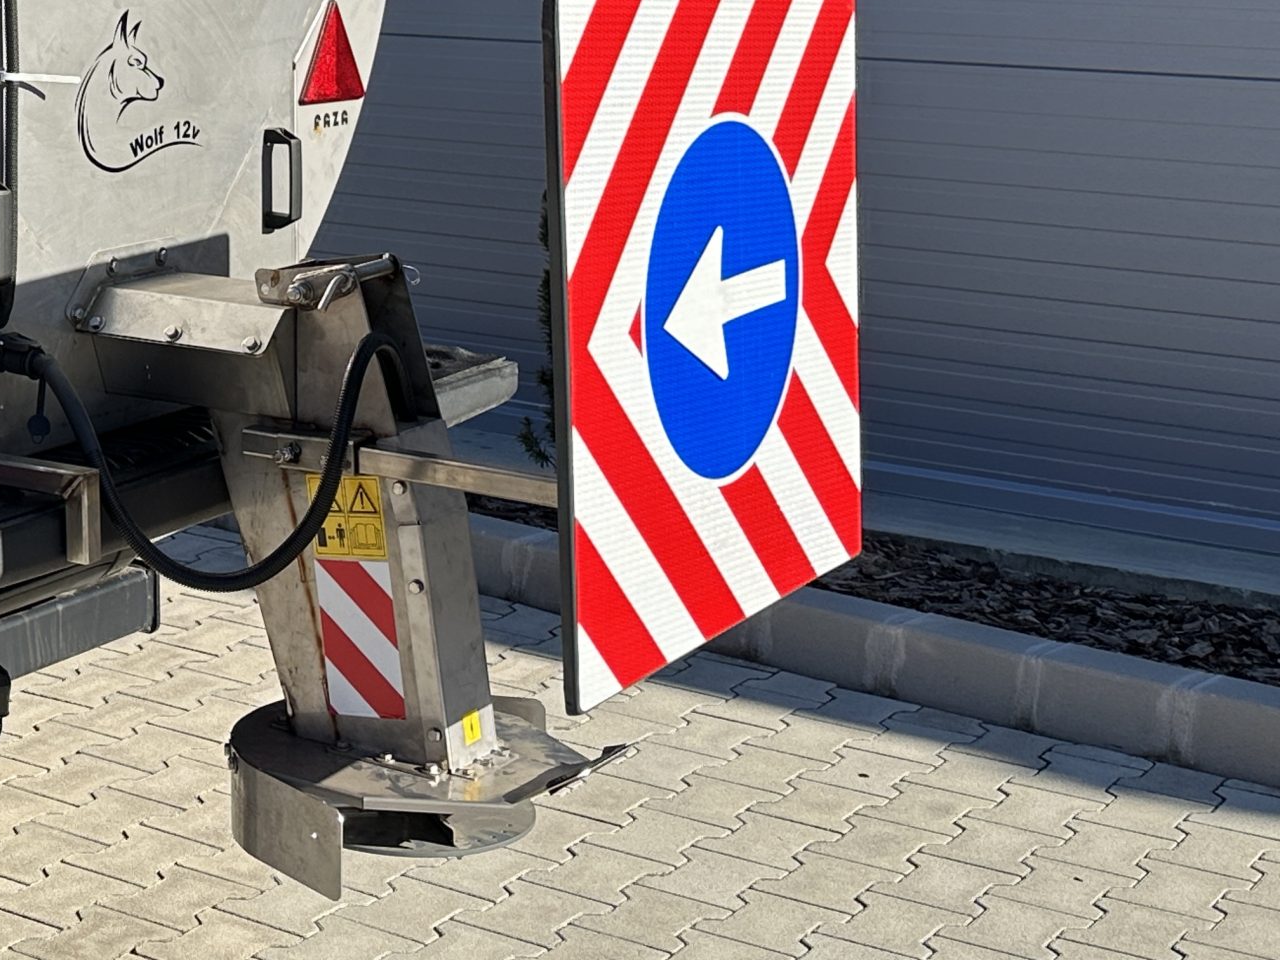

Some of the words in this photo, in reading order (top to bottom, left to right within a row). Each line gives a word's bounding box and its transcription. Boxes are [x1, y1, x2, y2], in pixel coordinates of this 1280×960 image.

[313, 109, 349, 131] FAZA
[129, 125, 164, 158] Wolf
[173, 120, 201, 140] 12v
